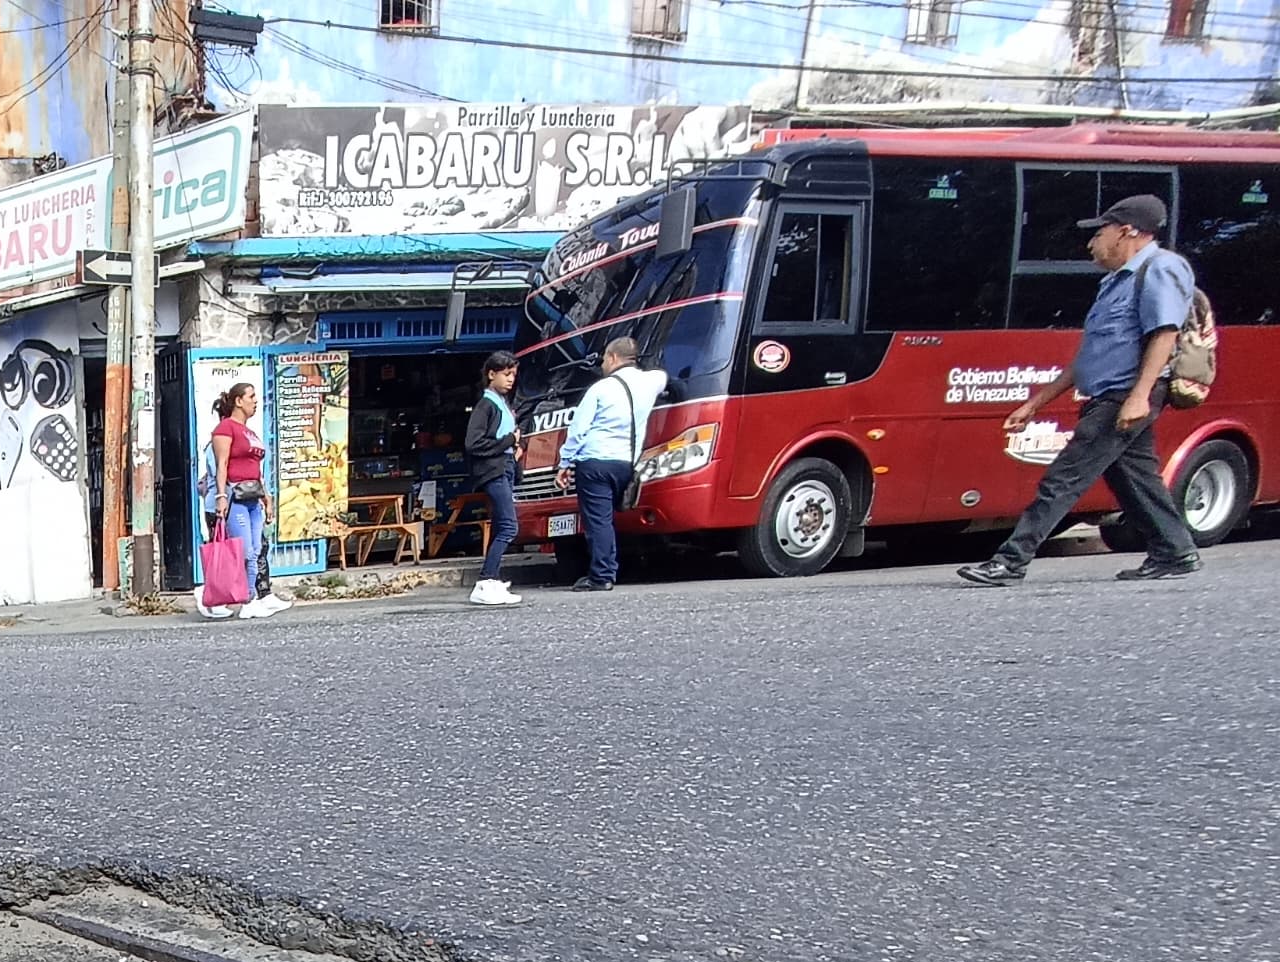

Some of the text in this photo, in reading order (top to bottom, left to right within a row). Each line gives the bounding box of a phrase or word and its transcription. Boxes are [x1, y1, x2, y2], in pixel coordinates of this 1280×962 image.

[457, 106, 520, 128] Parrilla
[526, 111, 536, 132] y
[324, 131, 536, 189] ICABARU
[0, 209, 8, 230] Y
[14, 183, 96, 227] LUNCHERIA
[559, 221, 660, 275] Colonia Tova
[279, 353, 342, 364] LUNCHERIA
[947, 368, 1006, 386] Gobierno
[945, 384, 1030, 403] de Venezuela
